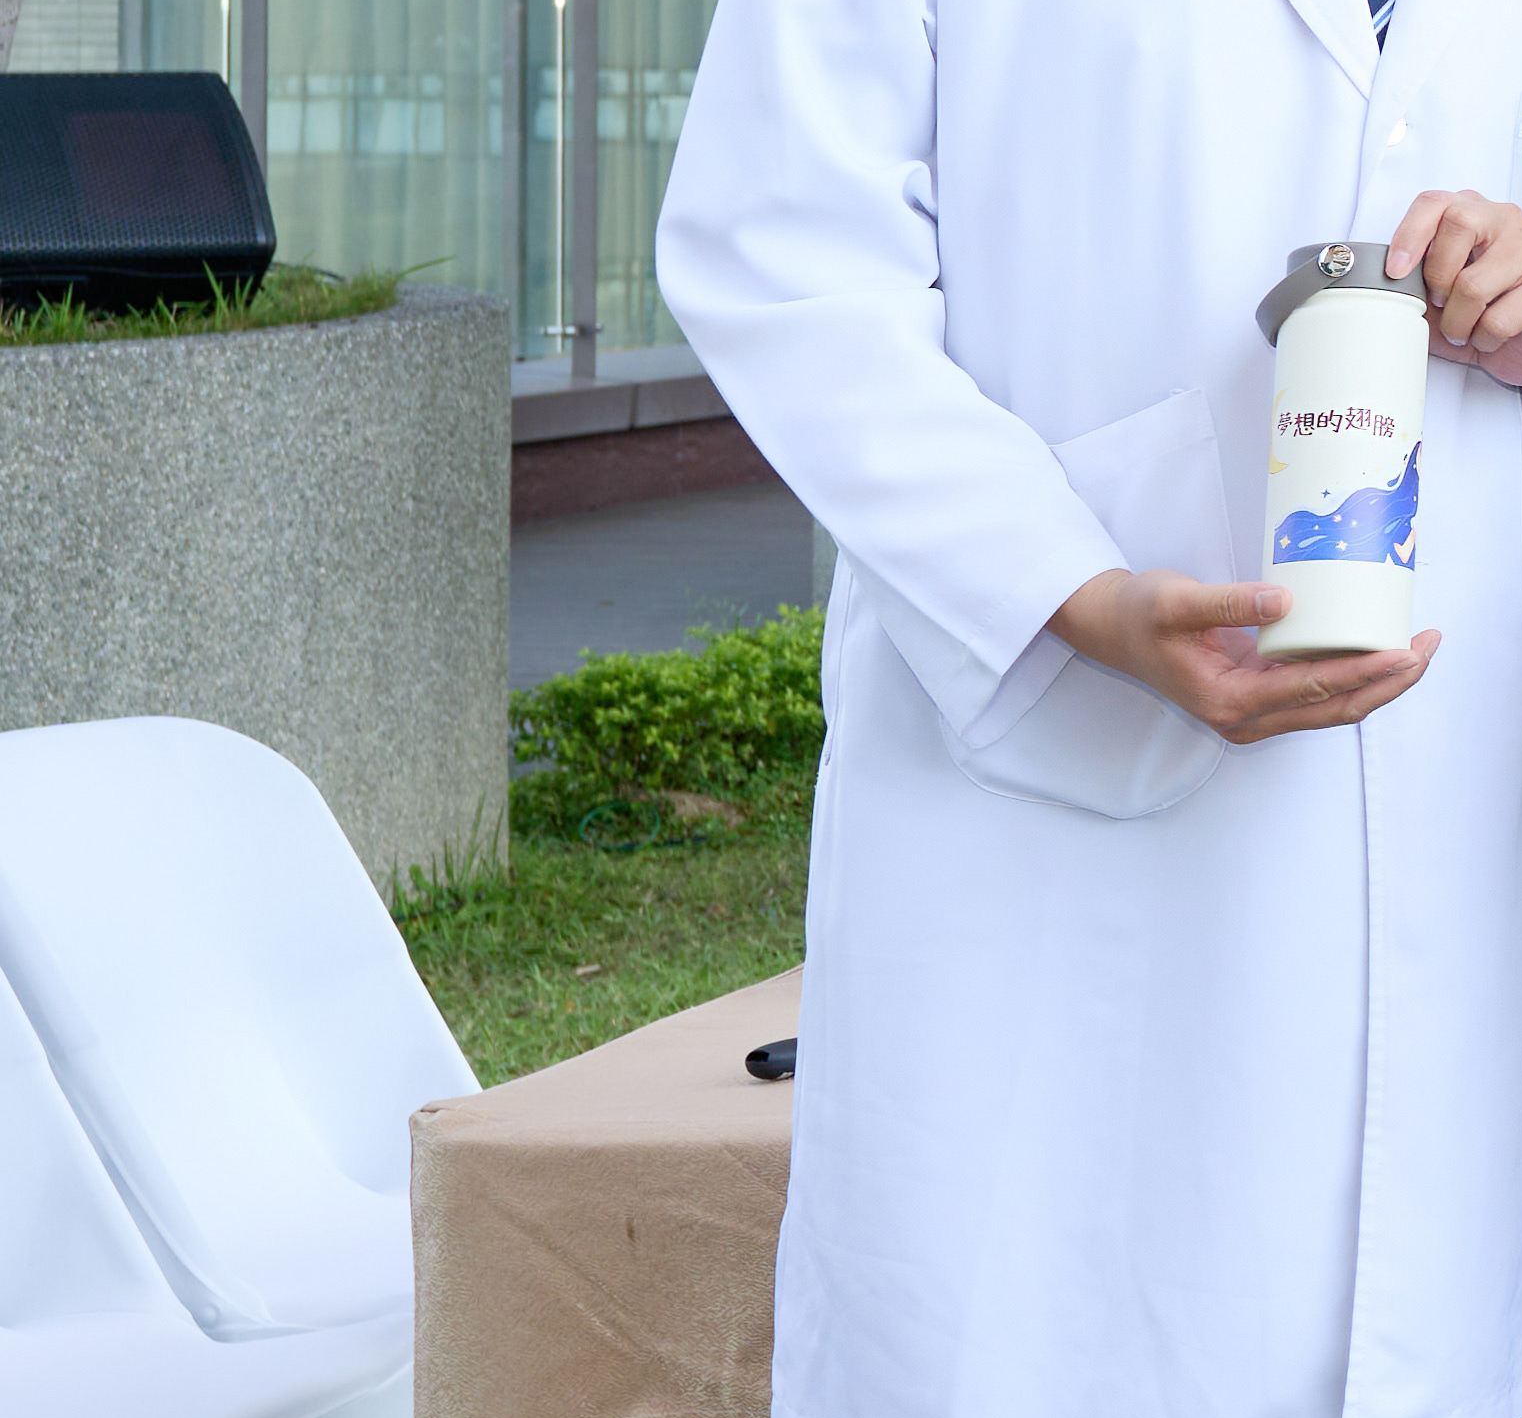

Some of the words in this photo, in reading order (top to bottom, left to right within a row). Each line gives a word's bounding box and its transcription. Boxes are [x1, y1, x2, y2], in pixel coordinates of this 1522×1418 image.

[1277, 407, 1395, 438] 夢想的翅膀
